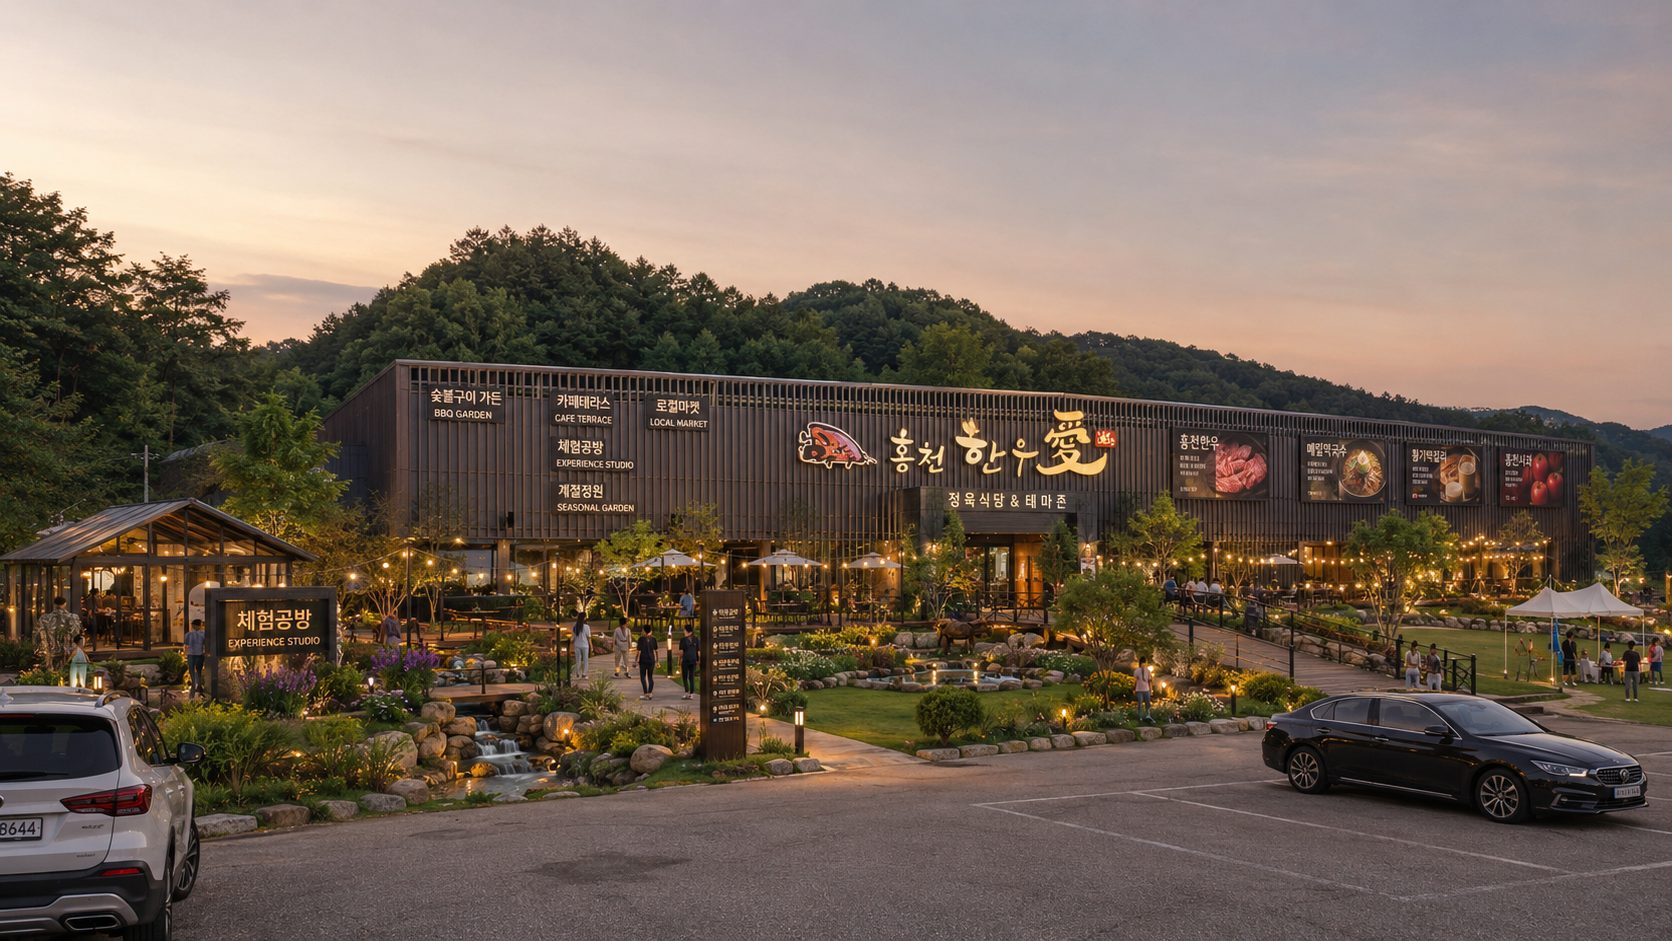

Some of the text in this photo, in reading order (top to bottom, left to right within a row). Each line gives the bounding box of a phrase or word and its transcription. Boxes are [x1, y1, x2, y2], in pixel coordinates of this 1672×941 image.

[431, 388, 502, 406] 숯불구이 가든
[556, 394, 611, 410] 카페테라스
[434, 408, 492, 419] BBQ GARDEN
[656, 399, 700, 414] 로컬마켓
[554, 413, 613, 424] CAFE TERRACE
[650, 418, 709, 428] LOCAL MARKET
[557, 439, 604, 456] 체험공방
[1180, 433, 1219, 451] 홍천한우
[889, 428, 945, 473] 홍천
[556, 459, 634, 470] EXPERIENCE STUDIO
[557, 503, 635, 512] SEASONAL GARDEN
[948, 492, 1067, 509] 정육식당 & 테마존
[237, 609, 312, 631] 체험공방
[228, 636, 321, 648] EXPERIENCE STUDIO
